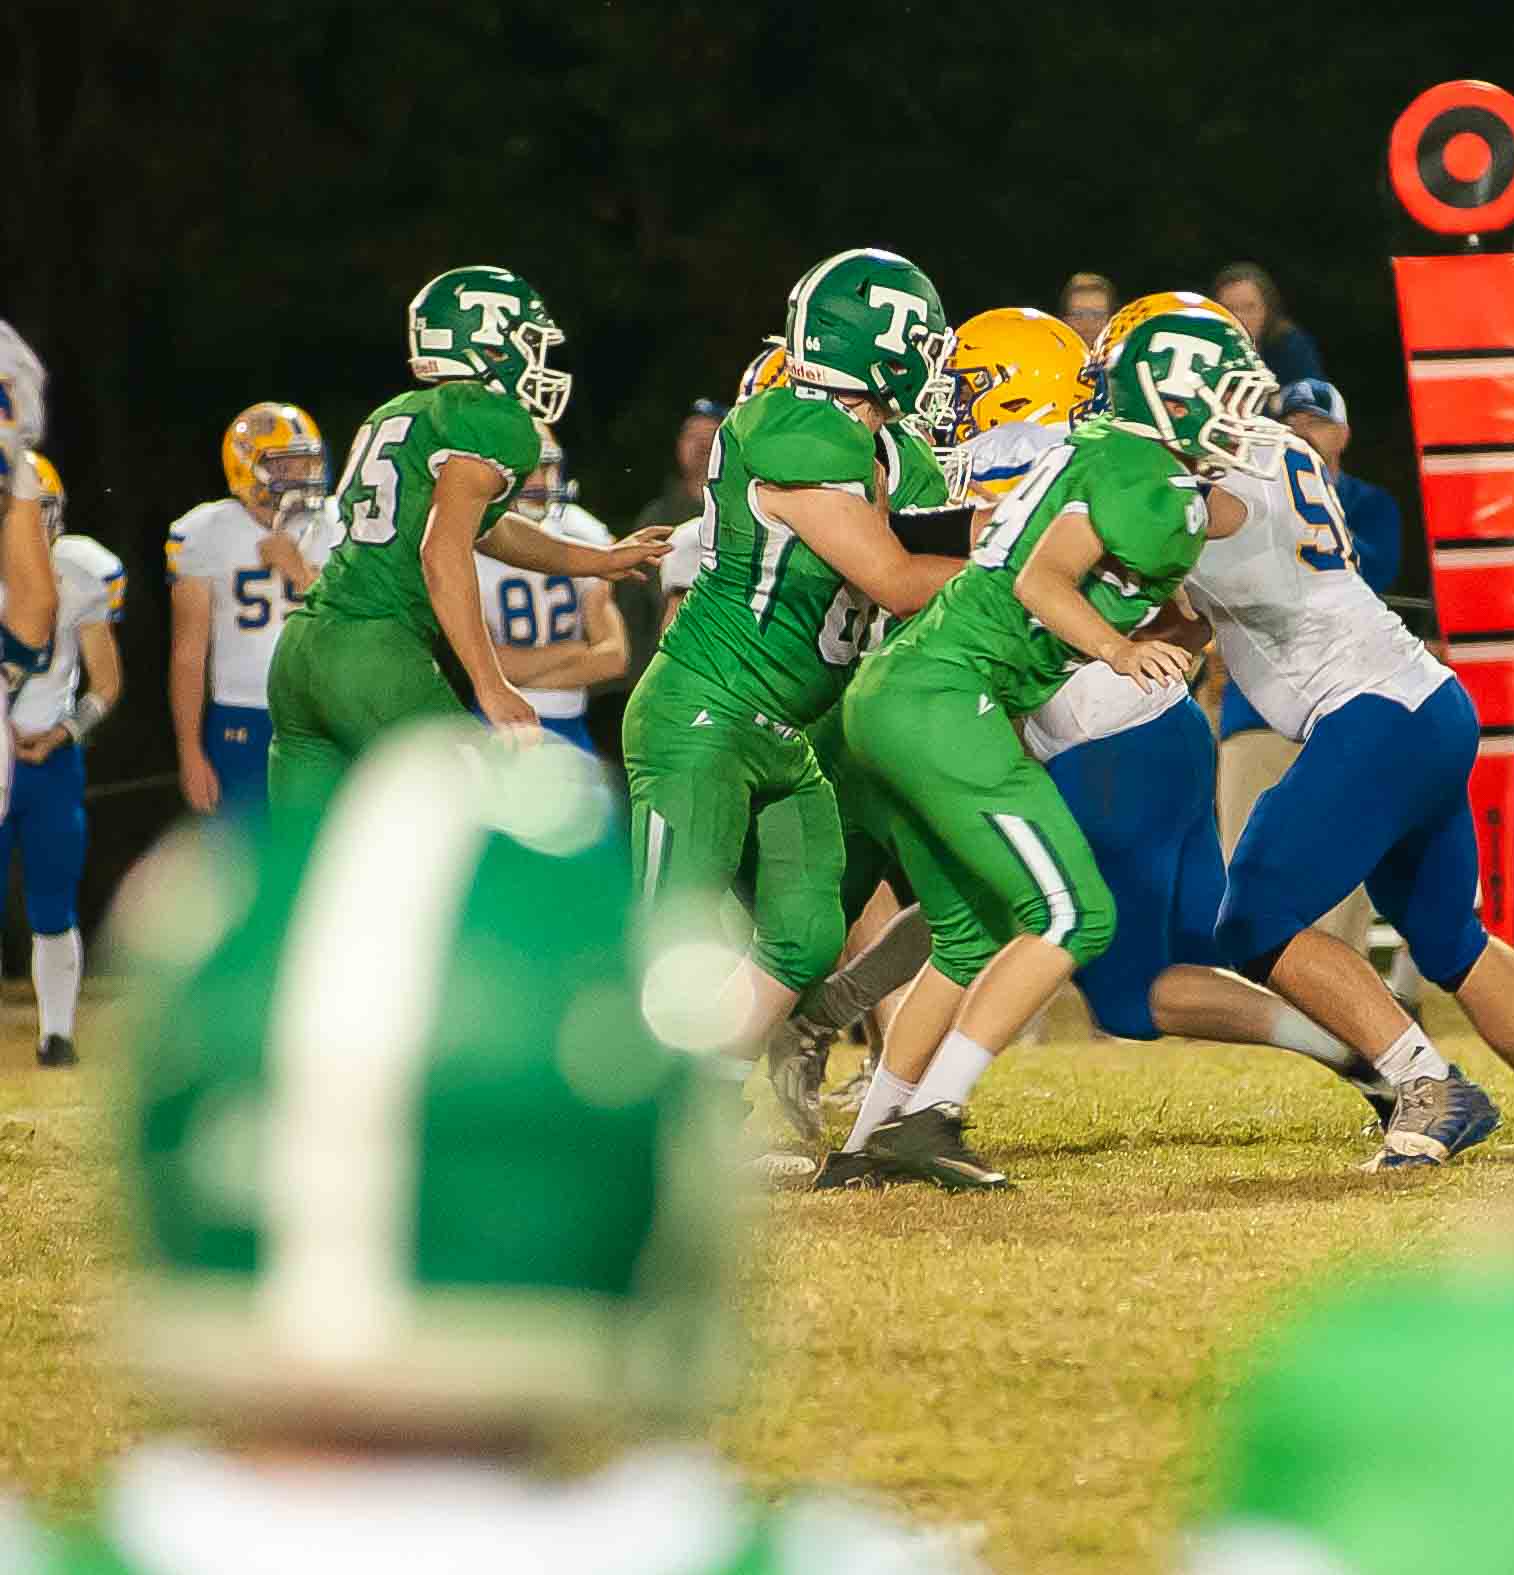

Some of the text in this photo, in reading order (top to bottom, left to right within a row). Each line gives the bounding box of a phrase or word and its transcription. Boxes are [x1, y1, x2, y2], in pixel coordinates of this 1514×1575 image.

[458, 290, 521, 346] T
[869, 284, 928, 354] T
[1148, 331, 1224, 398] T
[1279, 447, 1360, 576] 5
[498, 575, 578, 647] 82
